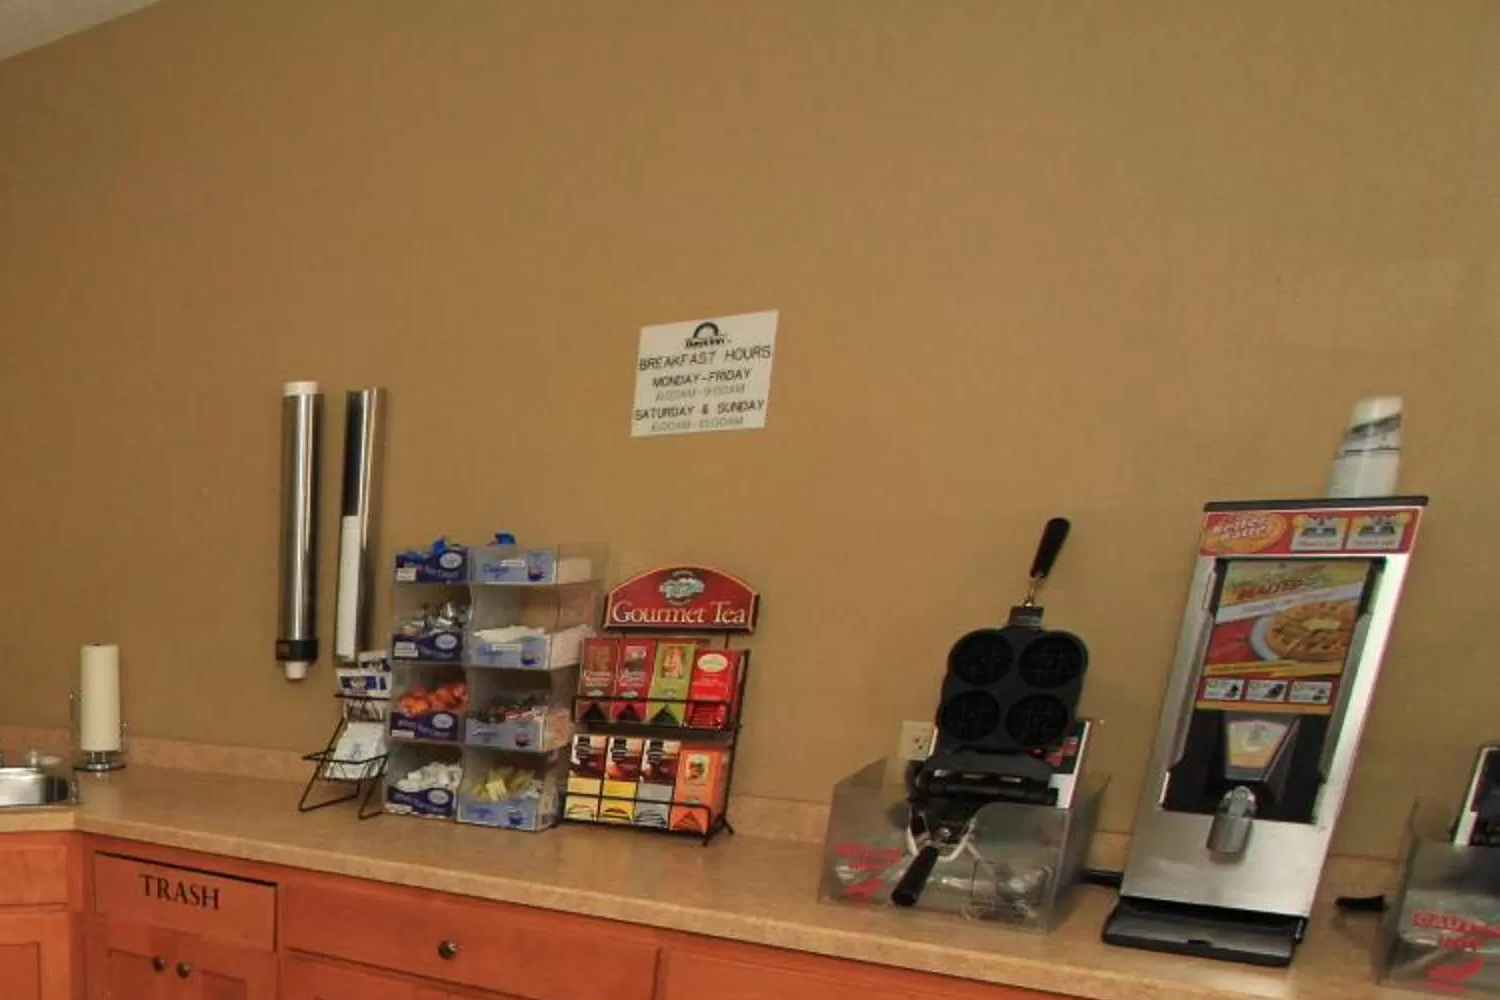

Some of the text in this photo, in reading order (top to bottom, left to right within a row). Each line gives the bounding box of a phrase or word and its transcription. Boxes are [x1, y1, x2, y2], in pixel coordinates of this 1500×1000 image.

[638, 344, 772, 371] BREAKFAST HOURS
[635, 405, 696, 421] SATURDAY
[717, 399, 765, 414] SUNDAY
[612, 600, 746, 624] Gourmet Tea
[138, 873, 220, 911] TRASH
